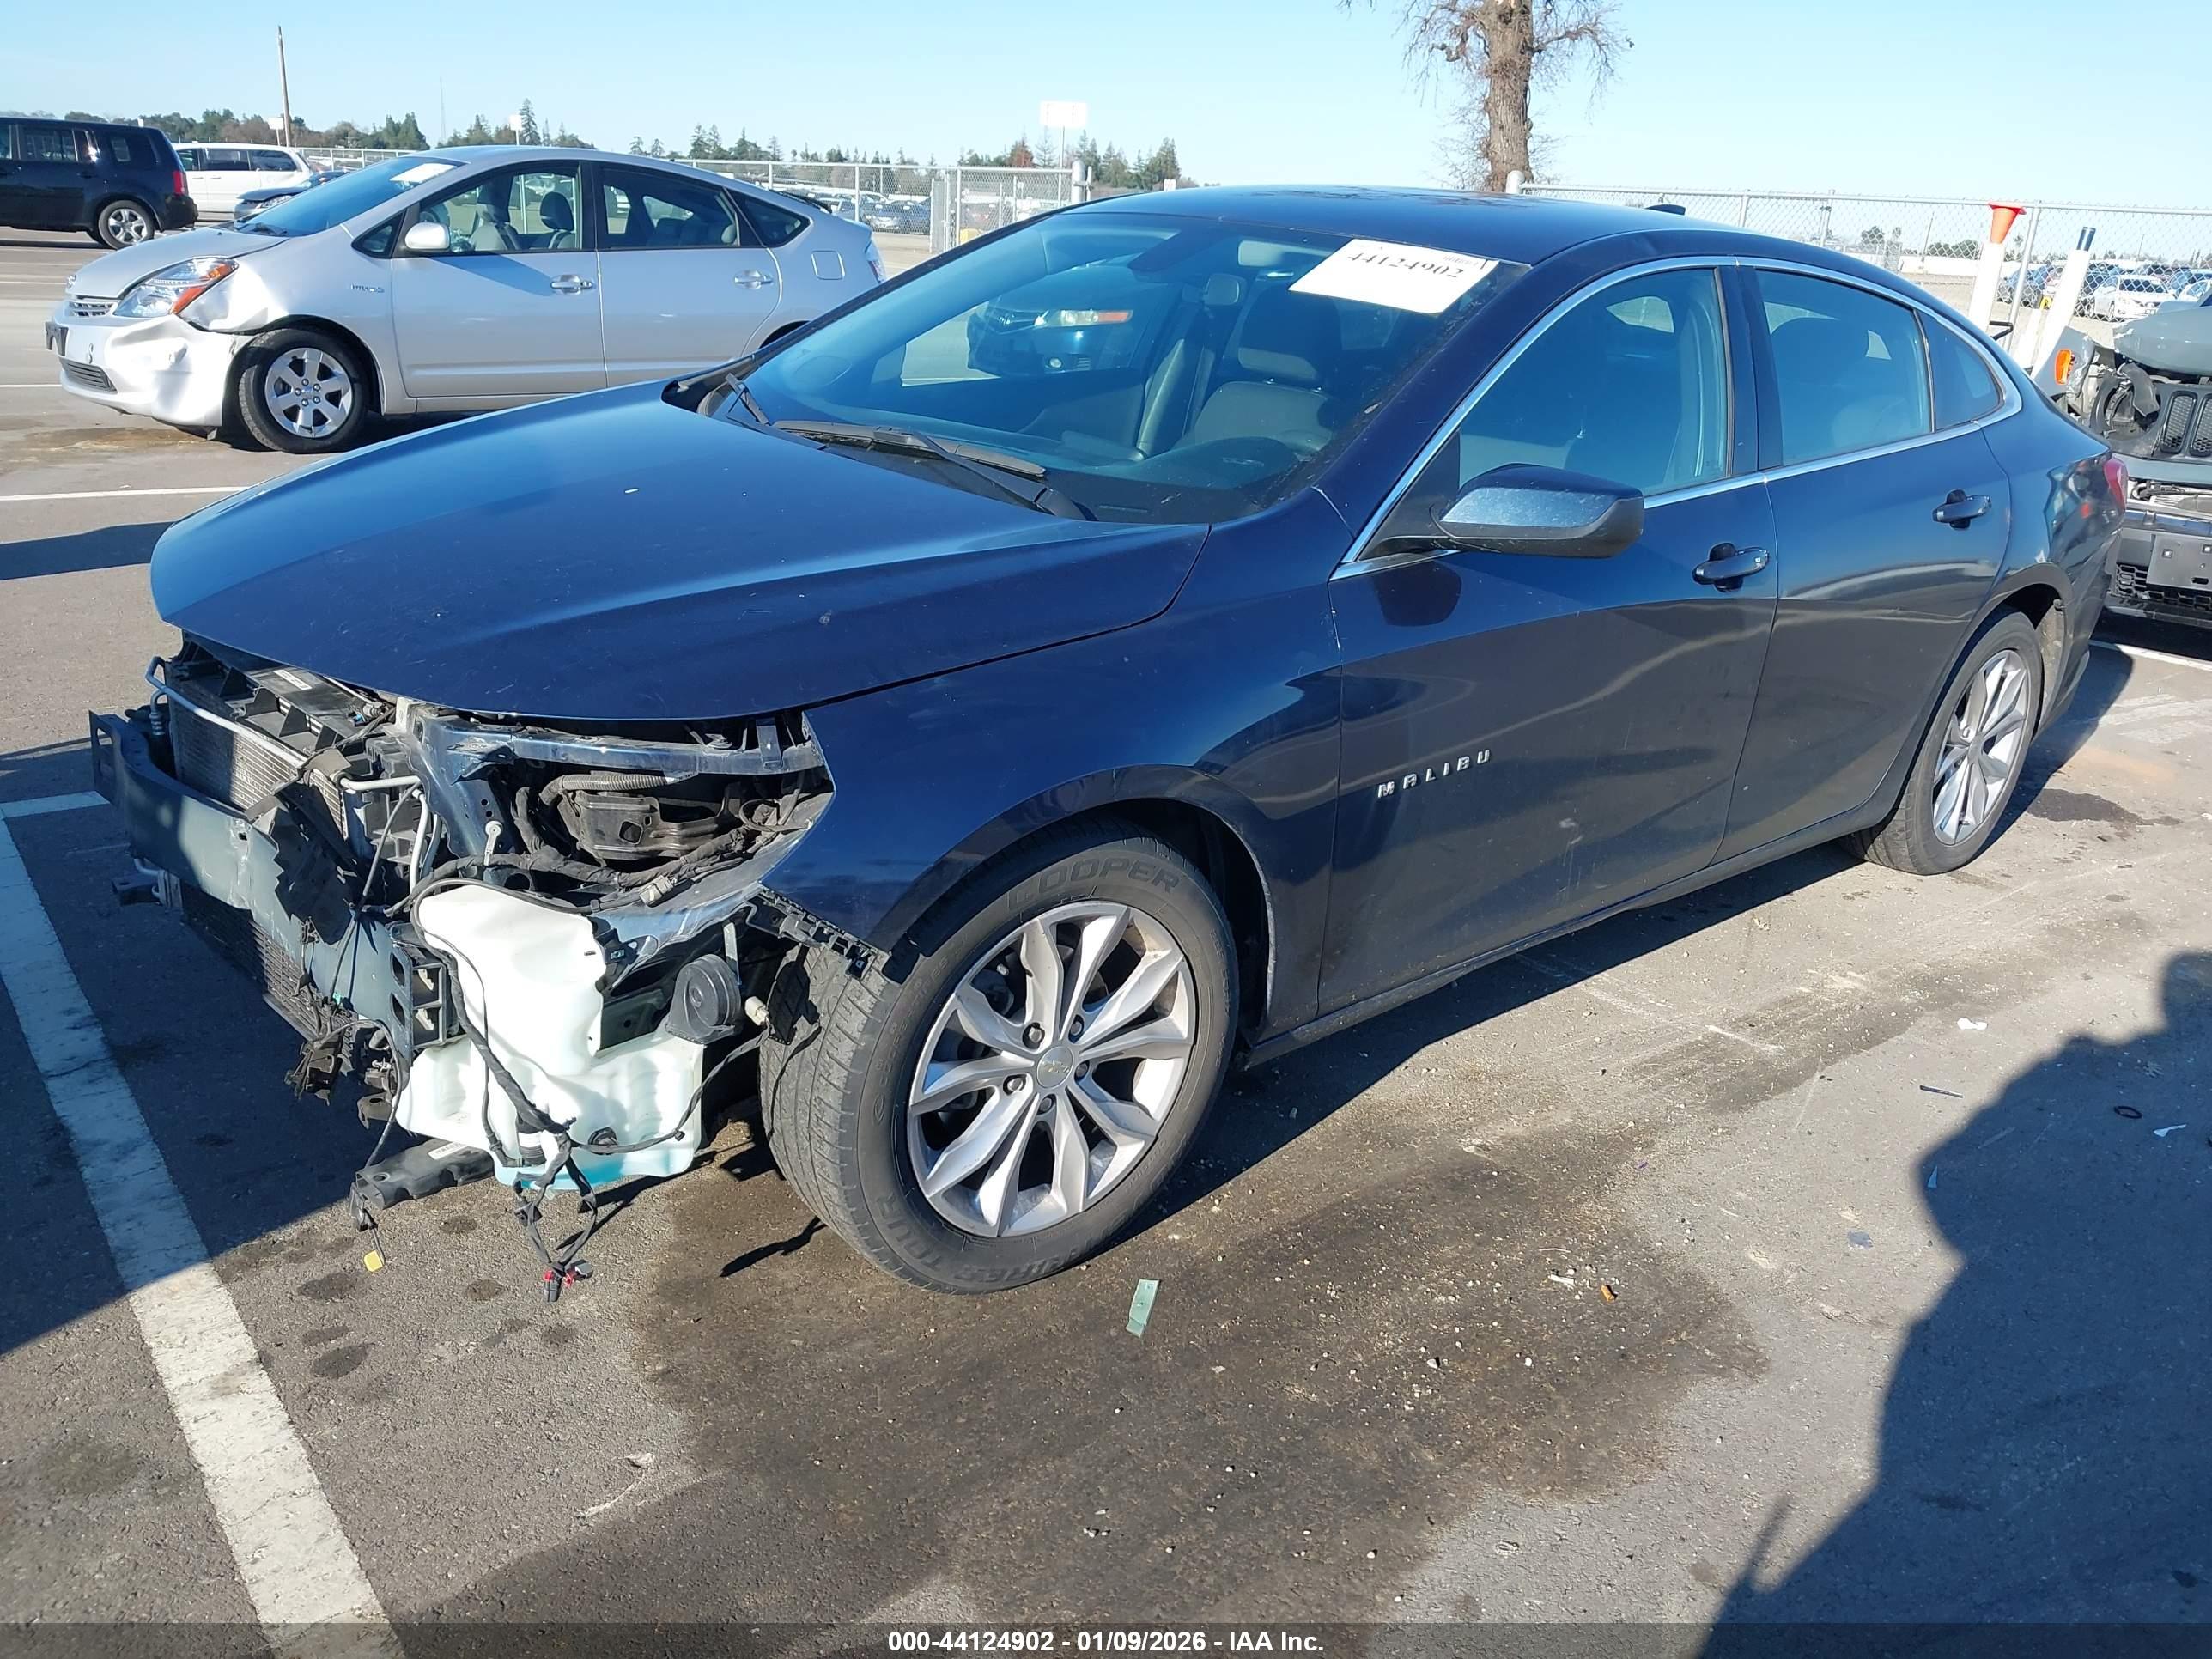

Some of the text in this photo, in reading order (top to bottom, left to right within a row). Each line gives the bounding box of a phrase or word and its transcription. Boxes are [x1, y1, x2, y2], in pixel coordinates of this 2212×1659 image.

[1347, 252, 1464, 278] 44124902
[1376, 748, 1491, 799] MALIBU
[1006, 858, 1181, 913] COOPER
